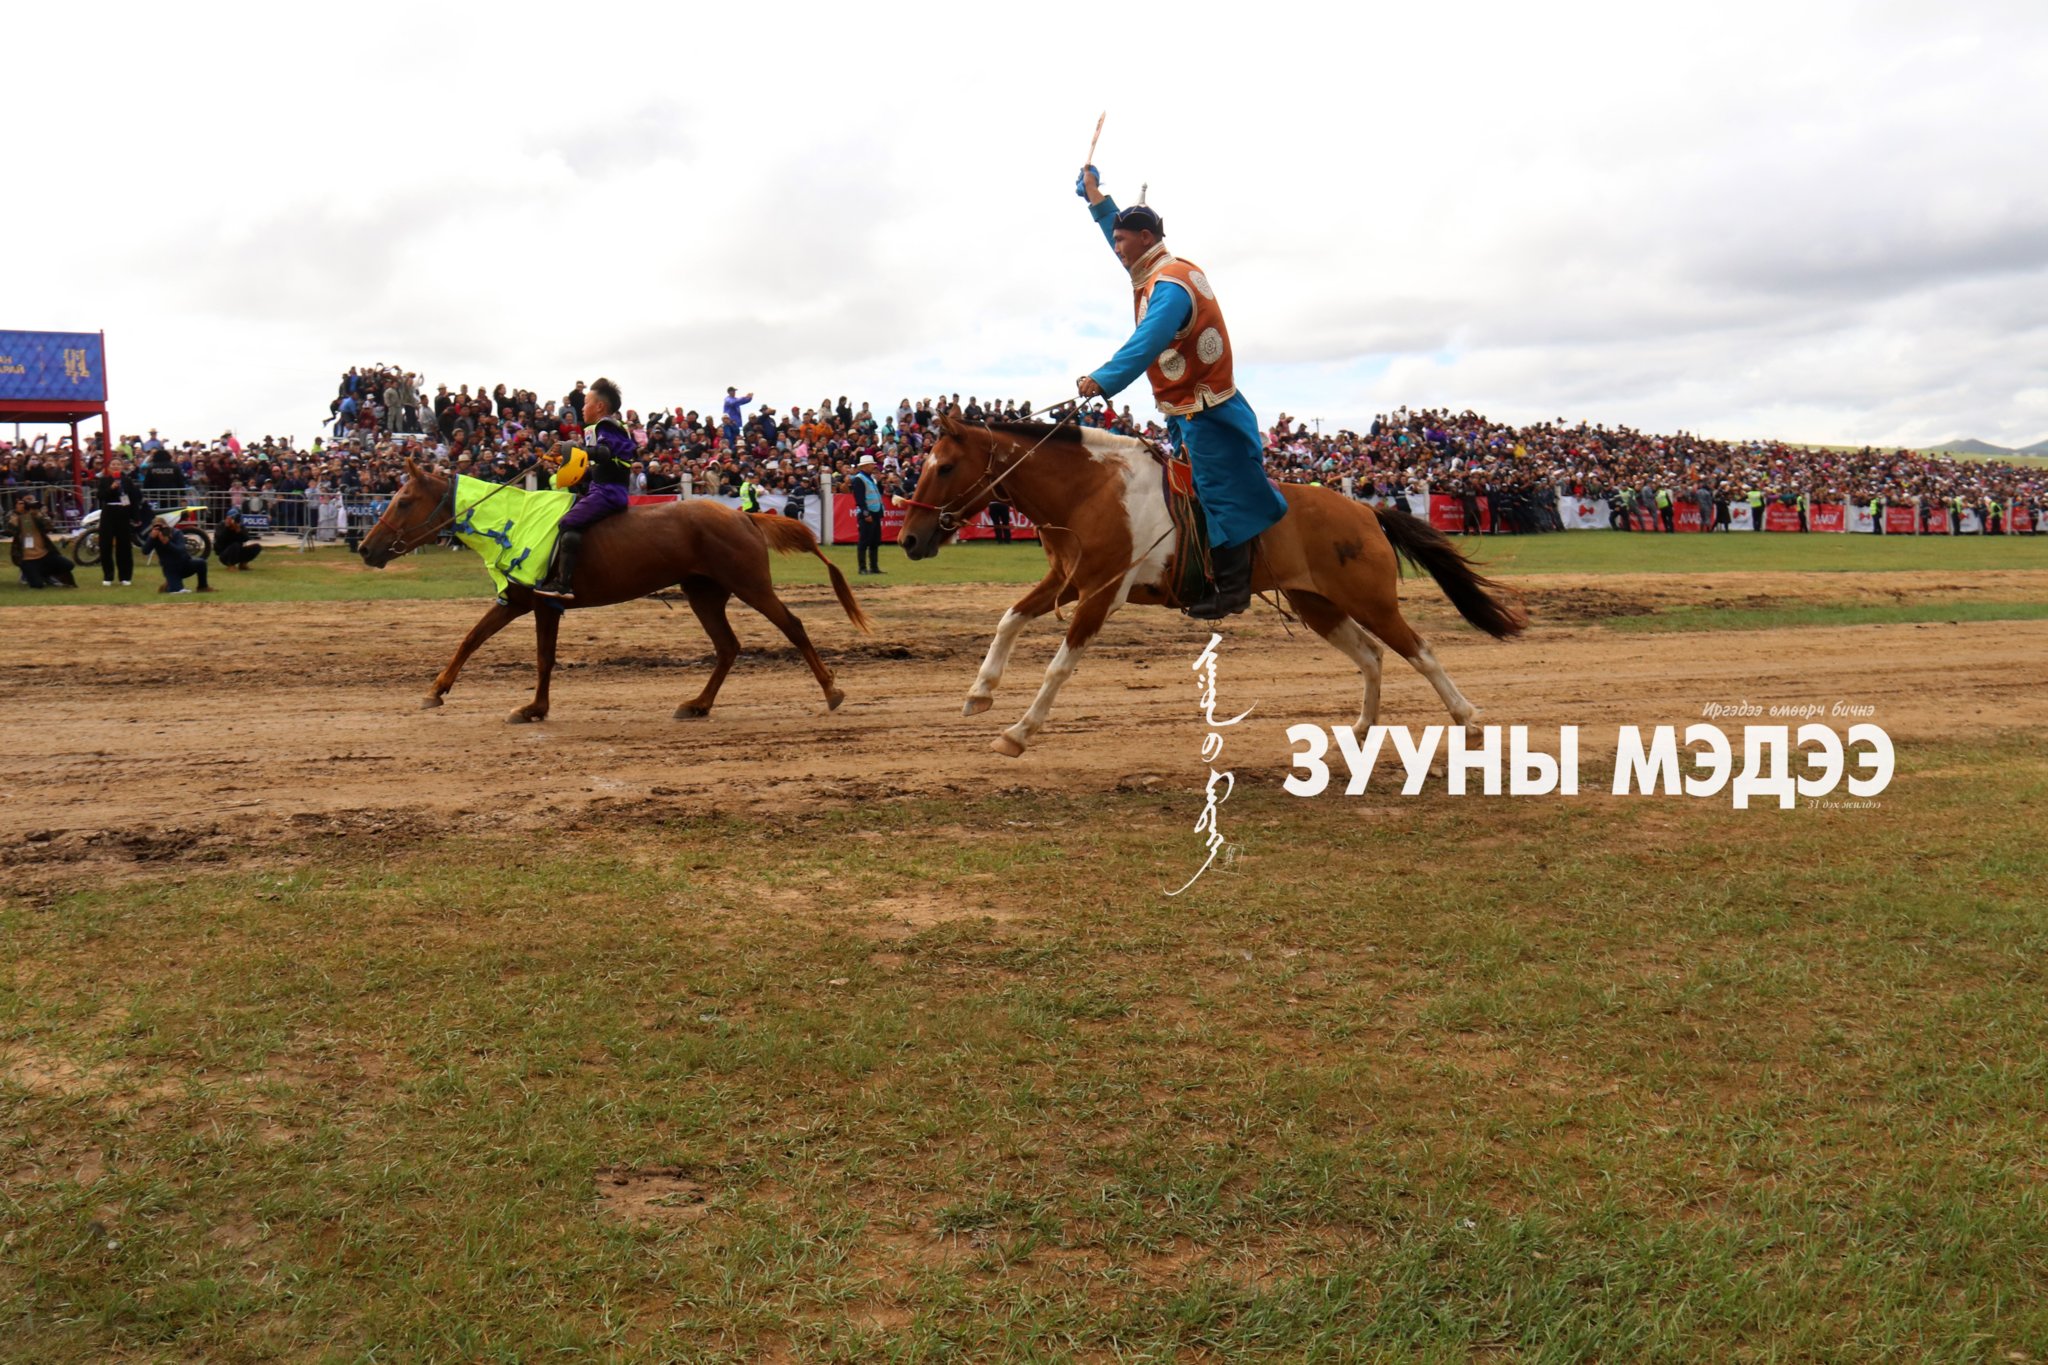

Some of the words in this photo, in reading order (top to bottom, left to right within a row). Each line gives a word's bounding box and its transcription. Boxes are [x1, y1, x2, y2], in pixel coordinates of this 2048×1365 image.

[151, 467, 174, 475] POLICE
[346, 506, 374, 516] POLICE
[242, 516, 269, 526] POLICE
